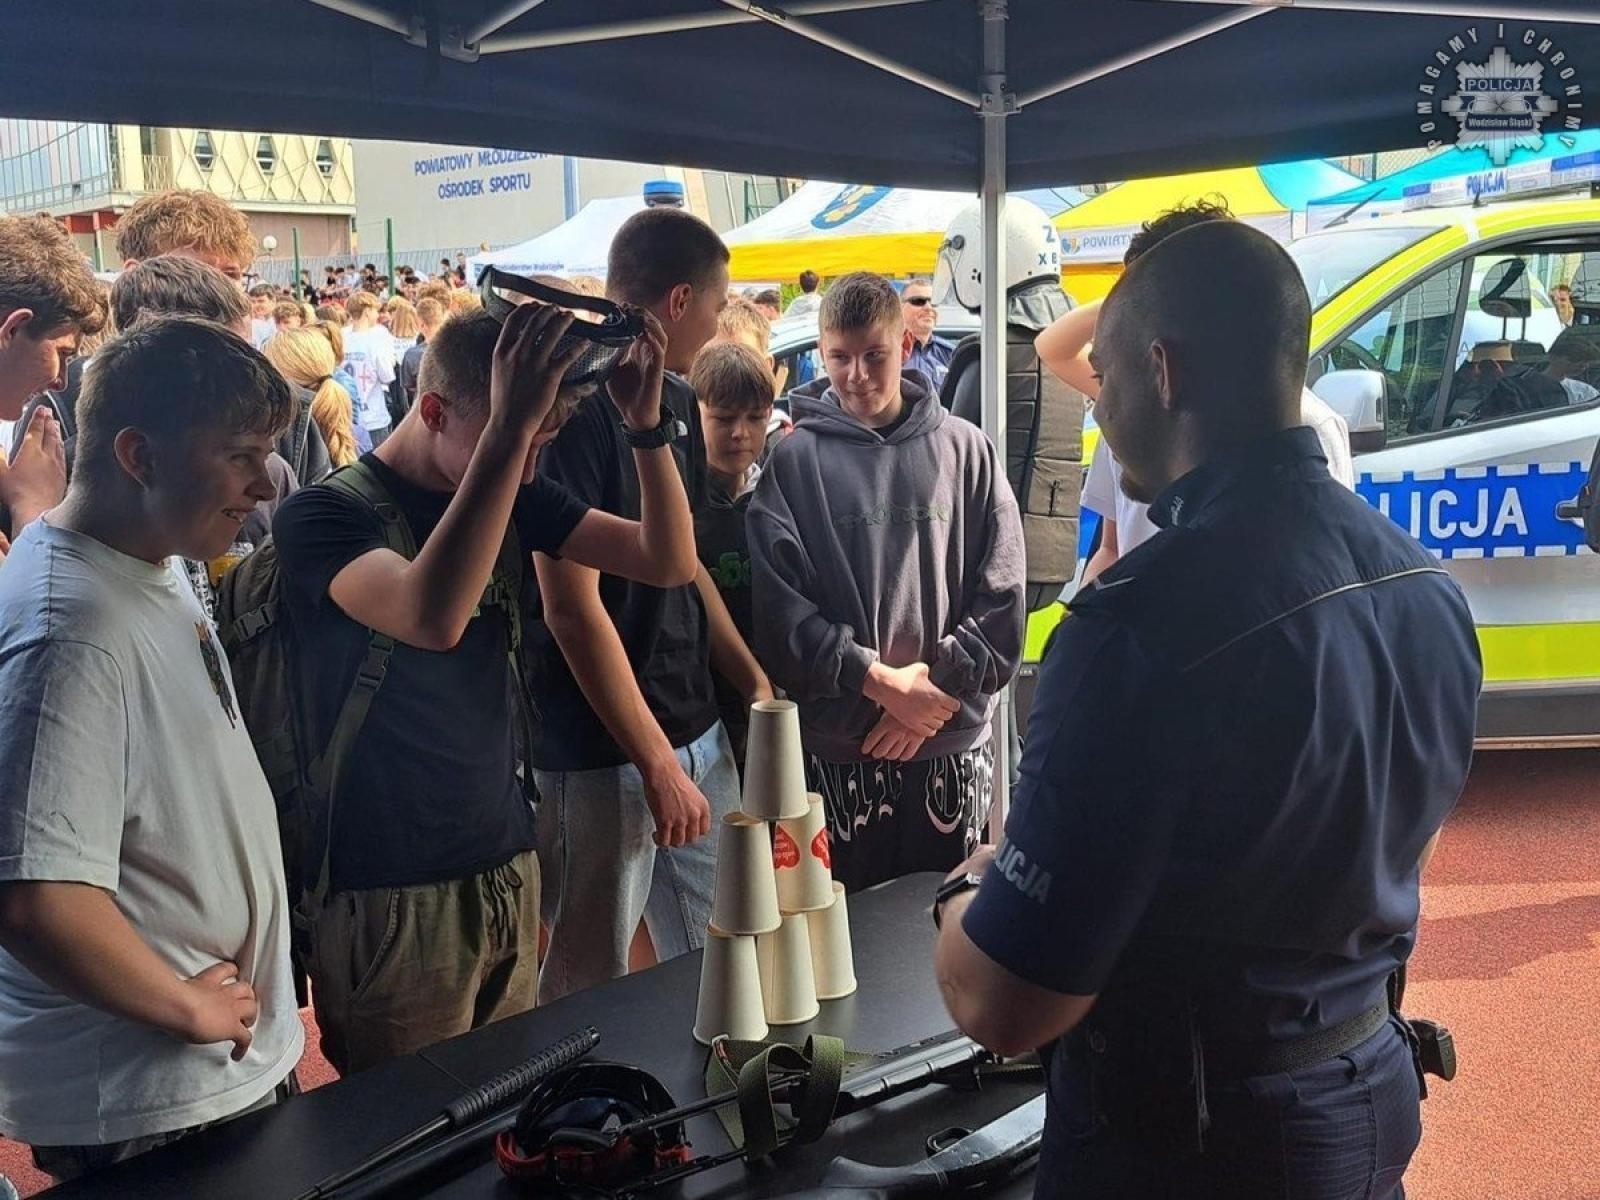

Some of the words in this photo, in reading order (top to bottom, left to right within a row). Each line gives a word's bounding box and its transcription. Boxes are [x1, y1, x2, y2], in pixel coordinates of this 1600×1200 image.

[414, 154, 474, 176] POWIATOWY
[478, 150, 549, 166] MŁODZIE
[438, 178, 485, 200] OŚRODEK
[490, 173, 531, 193] SPORTU
[1467, 171, 1505, 196] POLICJA
[1356, 487, 1528, 540] ICJA
